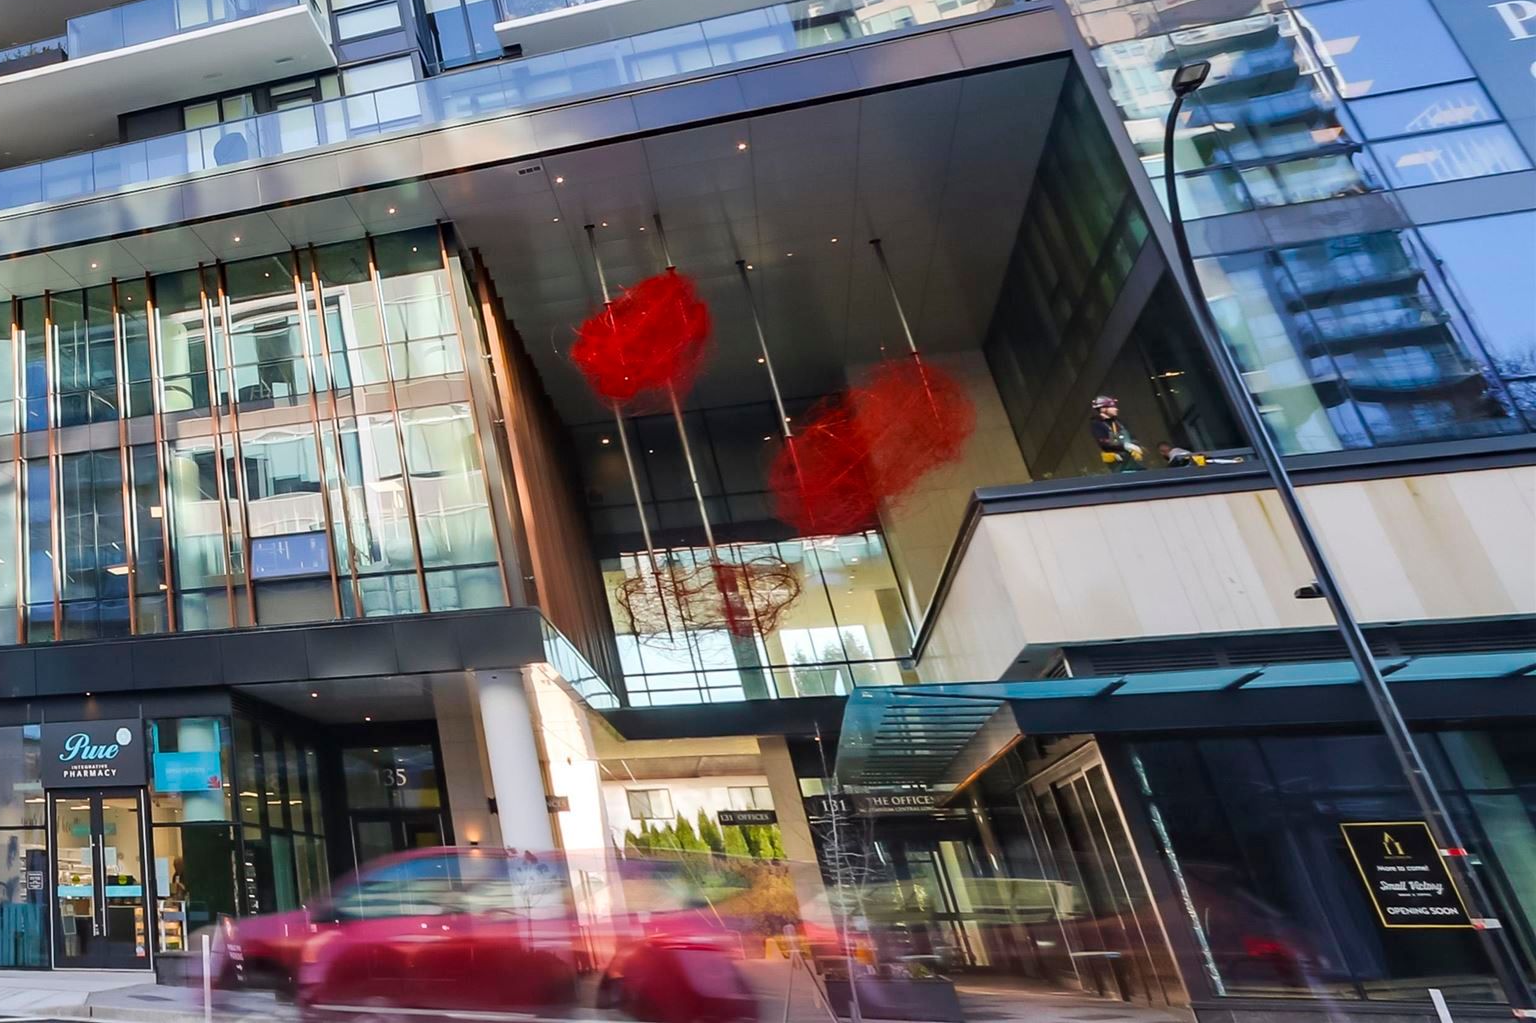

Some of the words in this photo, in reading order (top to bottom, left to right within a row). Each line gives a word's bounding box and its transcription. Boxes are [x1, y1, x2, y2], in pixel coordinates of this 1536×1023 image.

[59, 733, 120, 761] Pure
[63, 769, 117, 778] PHARMACY
[822, 799, 847, 812] 131
[1379, 880, 1407, 891] Small
[1408, 880, 1444, 895] Victory
[1386, 906, 1429, 915] OPENING
[1429, 906, 1460, 915] SOON
